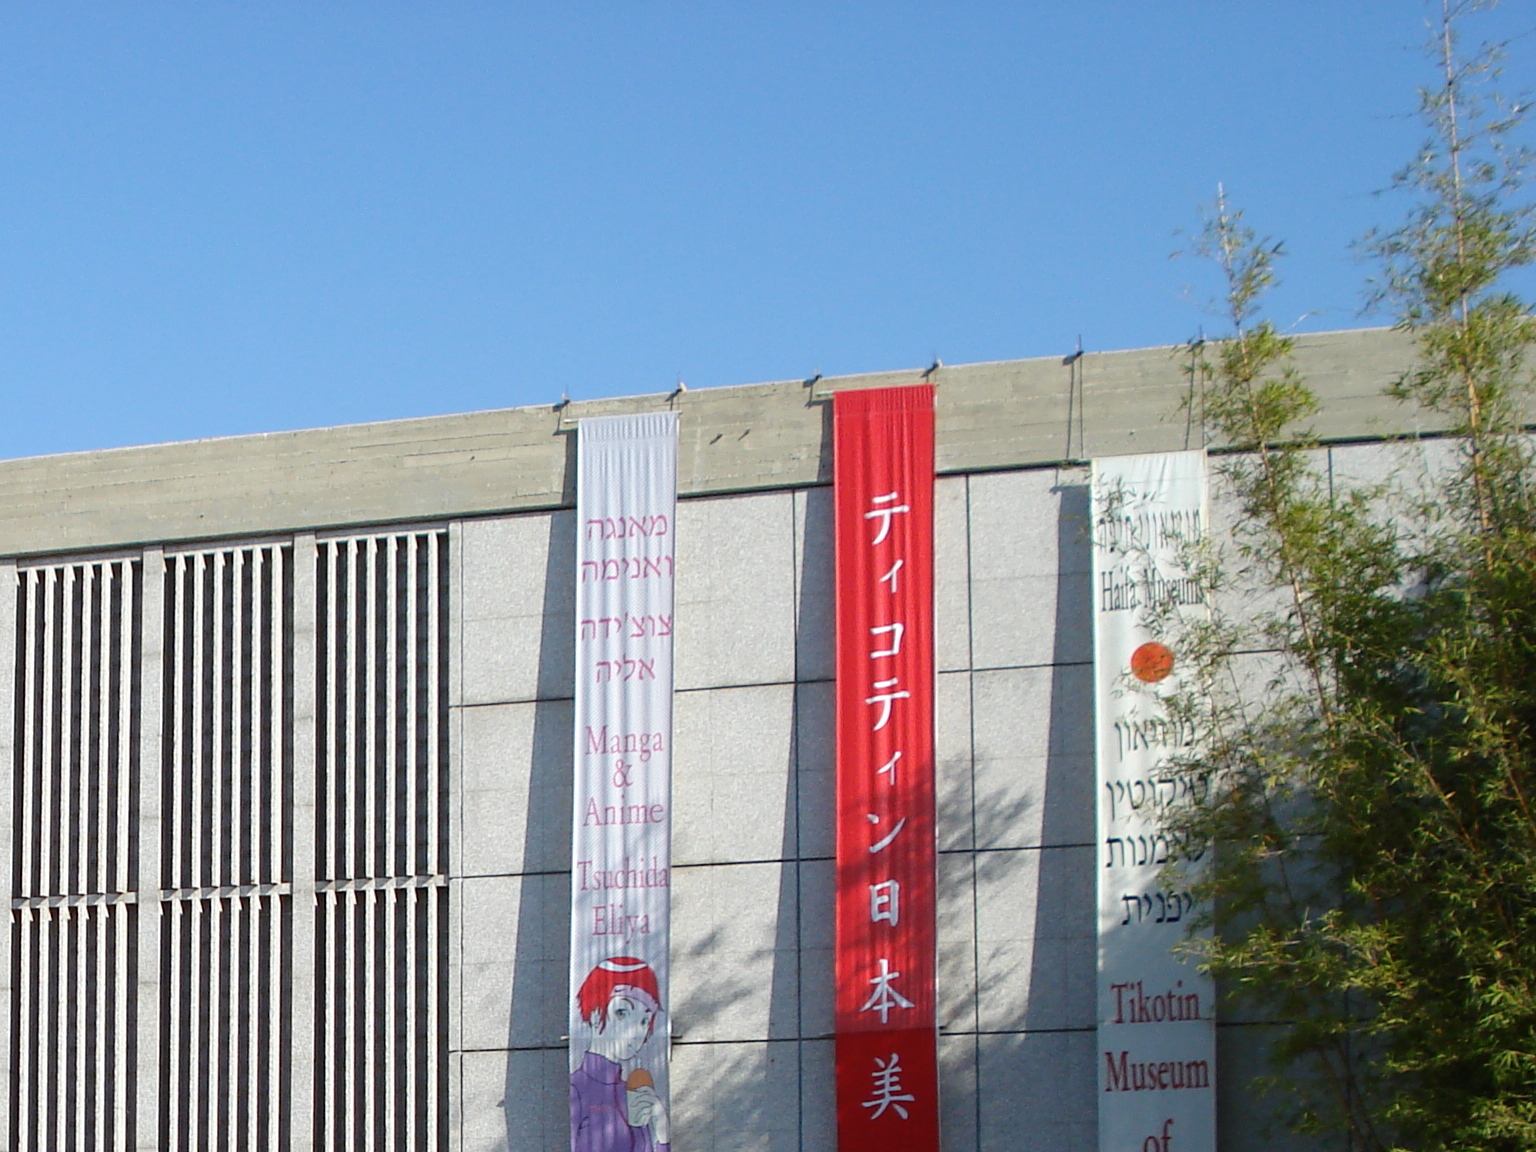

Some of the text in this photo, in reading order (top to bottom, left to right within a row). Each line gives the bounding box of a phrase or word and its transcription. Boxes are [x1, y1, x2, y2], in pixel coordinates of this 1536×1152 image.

[586, 514, 668, 540] מאנגה
[581, 555, 674, 582] ואנימה
[595, 652, 656, 683] אליה
[585, 724, 664, 762] Manga
[613, 758, 634, 788] &
[582, 794, 664, 827] Anime
[1105, 776, 1208, 823] טיקוטין
[577, 856, 670, 891] Tsuchida
[591, 904, 651, 945] Eliya
[1121, 891, 1193, 926] יפנית
[1110, 979, 1201, 1025] Tikotin
[1105, 1051, 1210, 1093] Museum
